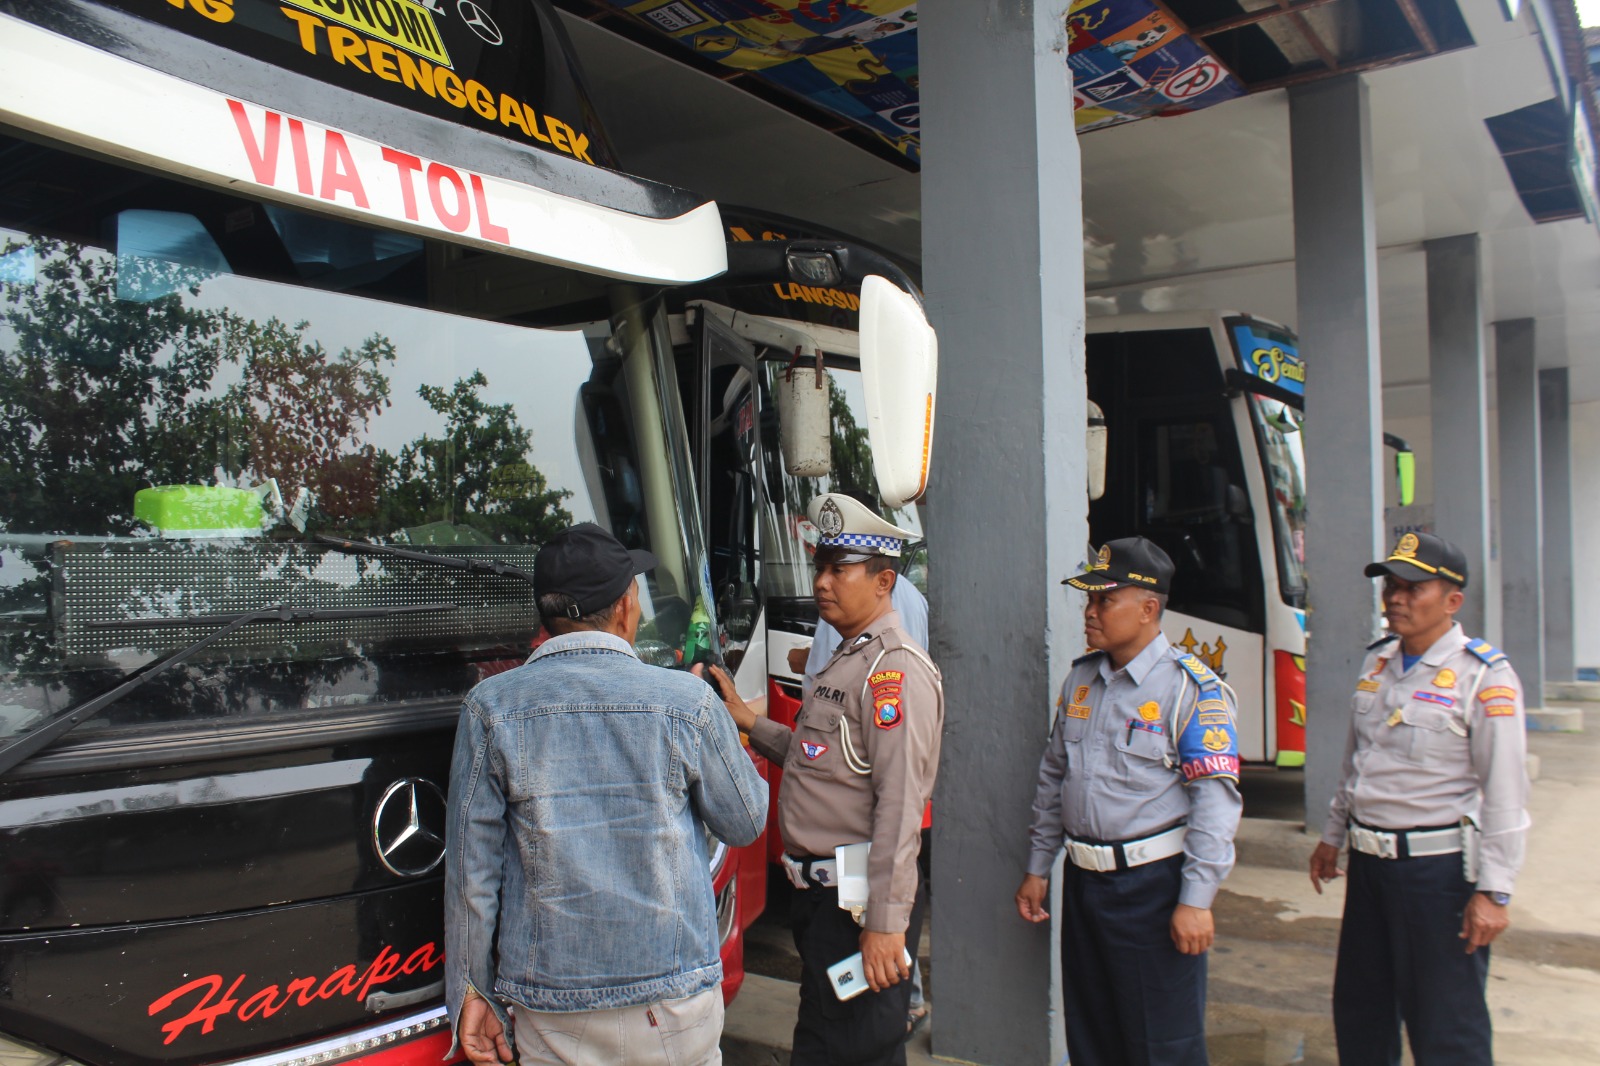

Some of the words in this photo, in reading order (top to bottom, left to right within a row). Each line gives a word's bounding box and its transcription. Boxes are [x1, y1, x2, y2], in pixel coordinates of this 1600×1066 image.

[303, 0, 442, 56] ONOMI
[652, 12, 679, 29] STOP
[279, 6, 596, 165] TRENGGALEK
[226, 98, 370, 209] VIA
[380, 145, 510, 245] TOL
[773, 282, 861, 312] LANGSU
[814, 685, 845, 703] POLRI
[871, 671, 902, 685] POLRES
[148, 941, 446, 1045] Harapa
